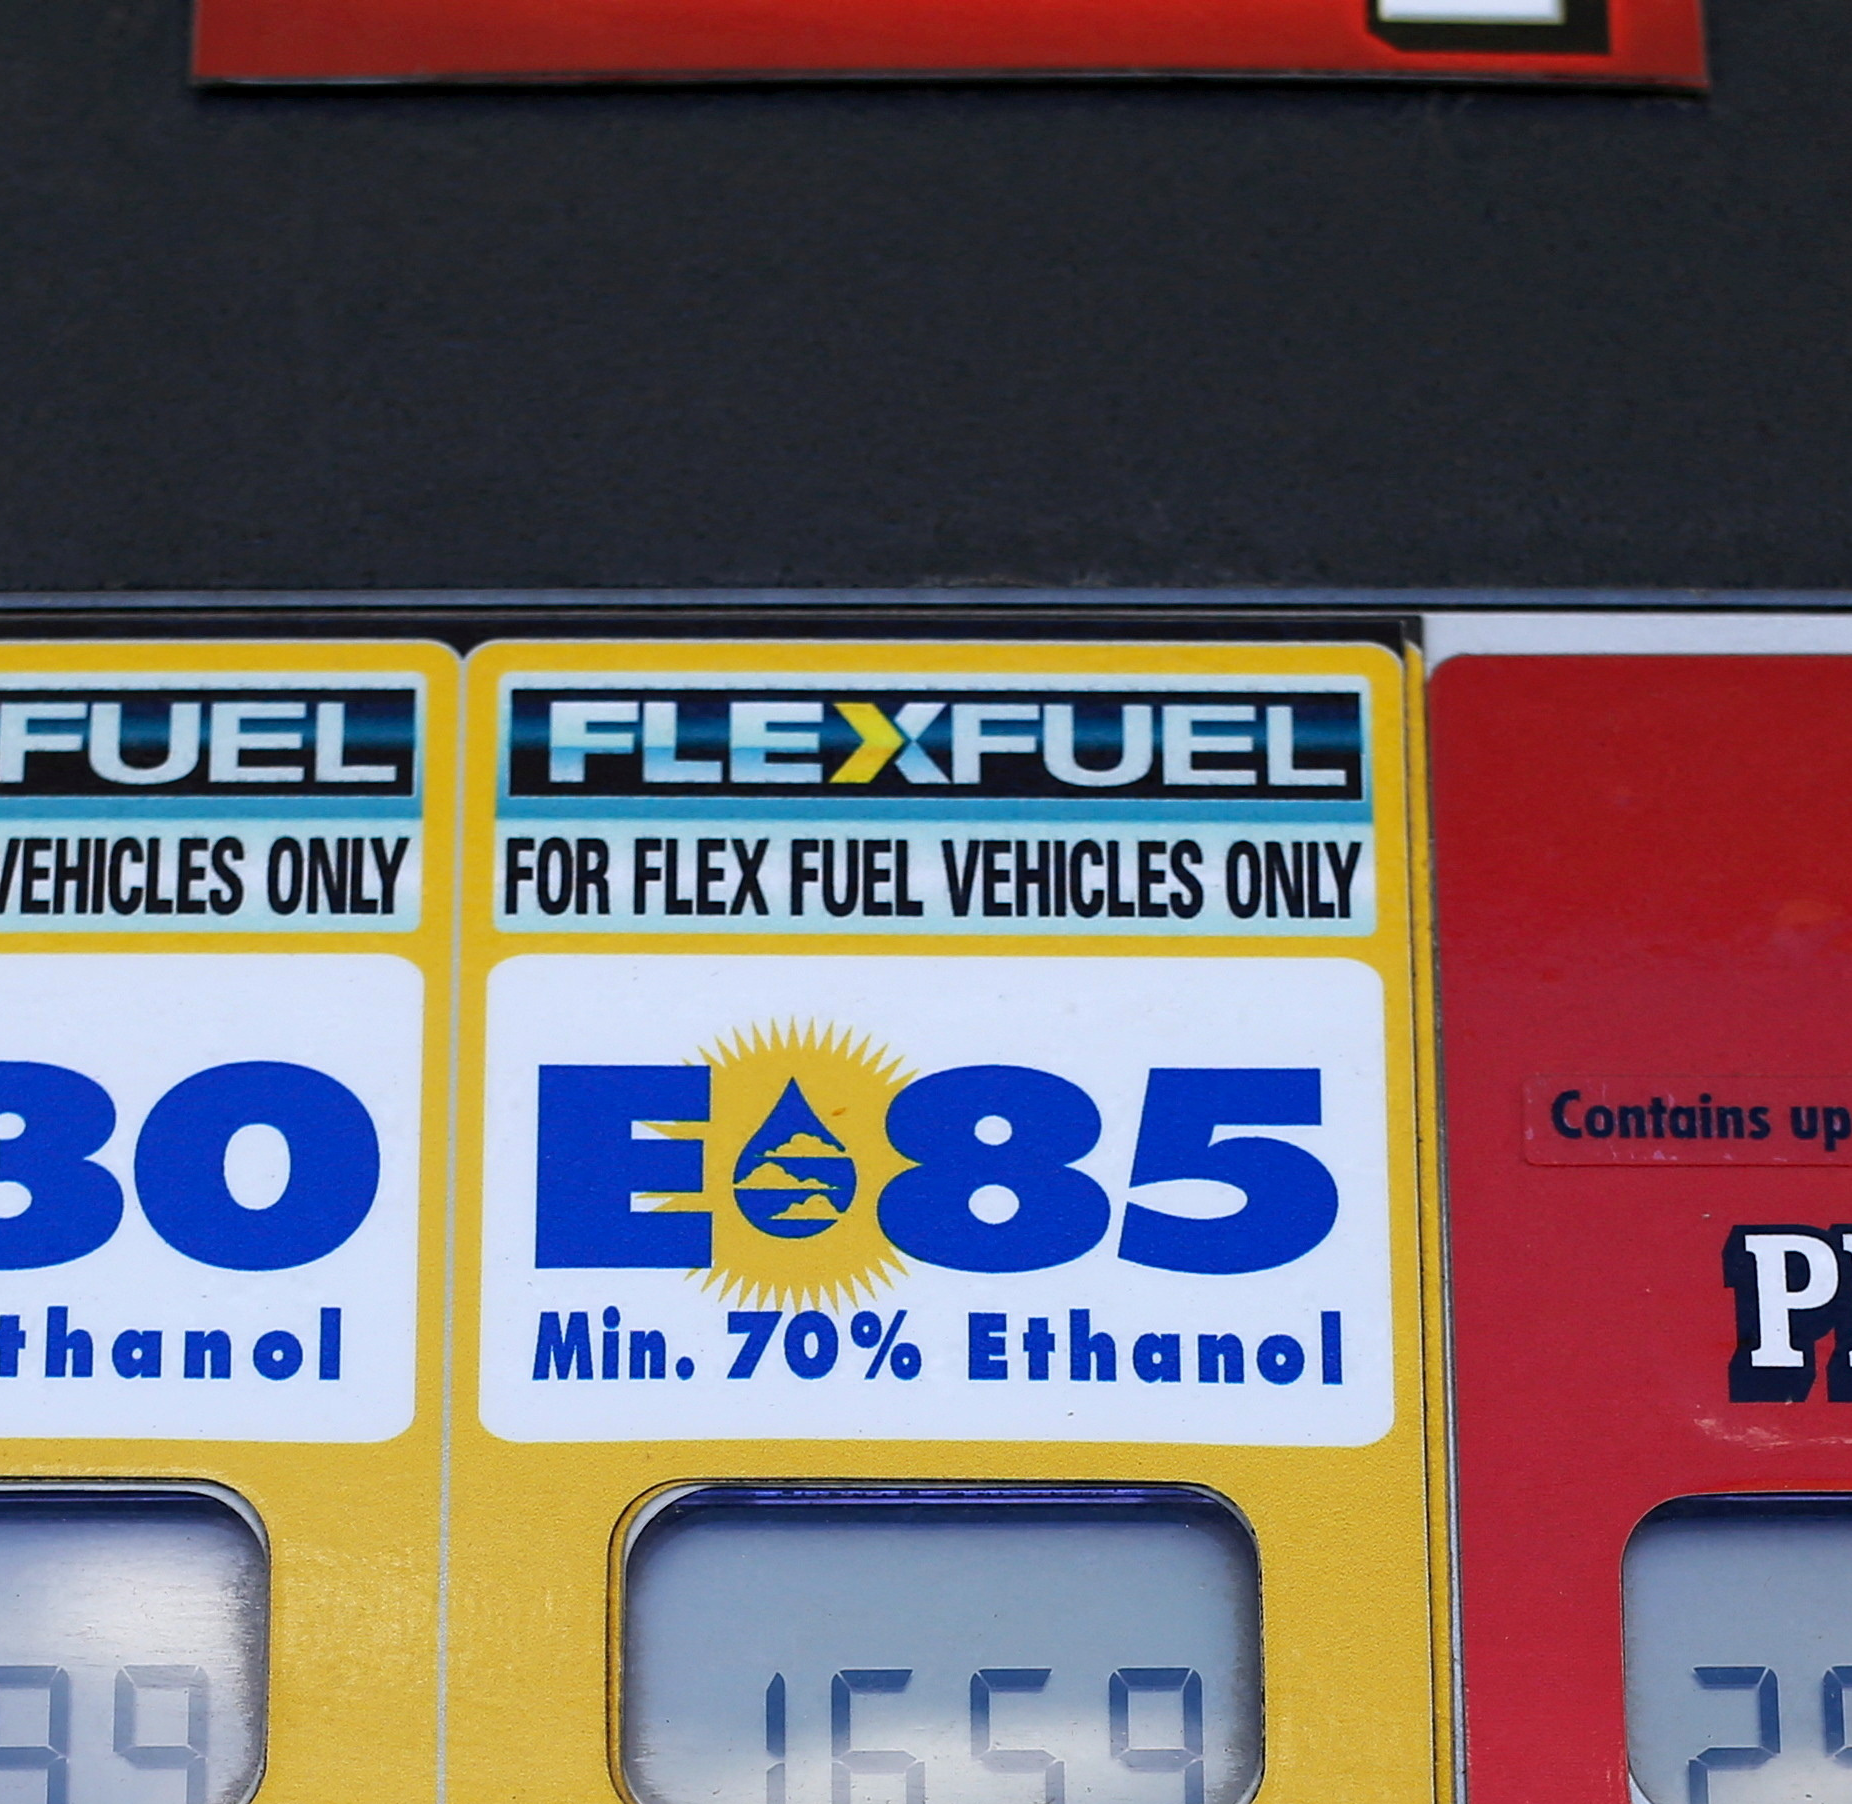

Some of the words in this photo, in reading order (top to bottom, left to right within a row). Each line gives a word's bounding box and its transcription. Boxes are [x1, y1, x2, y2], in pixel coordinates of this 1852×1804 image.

[550, 701, 1348, 787] FLEXFUEL
[267, 837, 409, 915] ONLY
[504, 838, 610, 915] FOR
[632, 838, 770, 916] FLEX
[790, 838, 923, 917] FUEL
[941, 839, 1204, 918] VEHICLES
[1226, 840, 1362, 919] ONLY
[1550, 1089, 1770, 1140] Contains
[1791, 1105, 1852, 1151] up
[532, 1305, 695, 1381] Min.
[725, 1309, 921, 1381] 70%
[967, 1307, 1343, 1384] Ethanol
